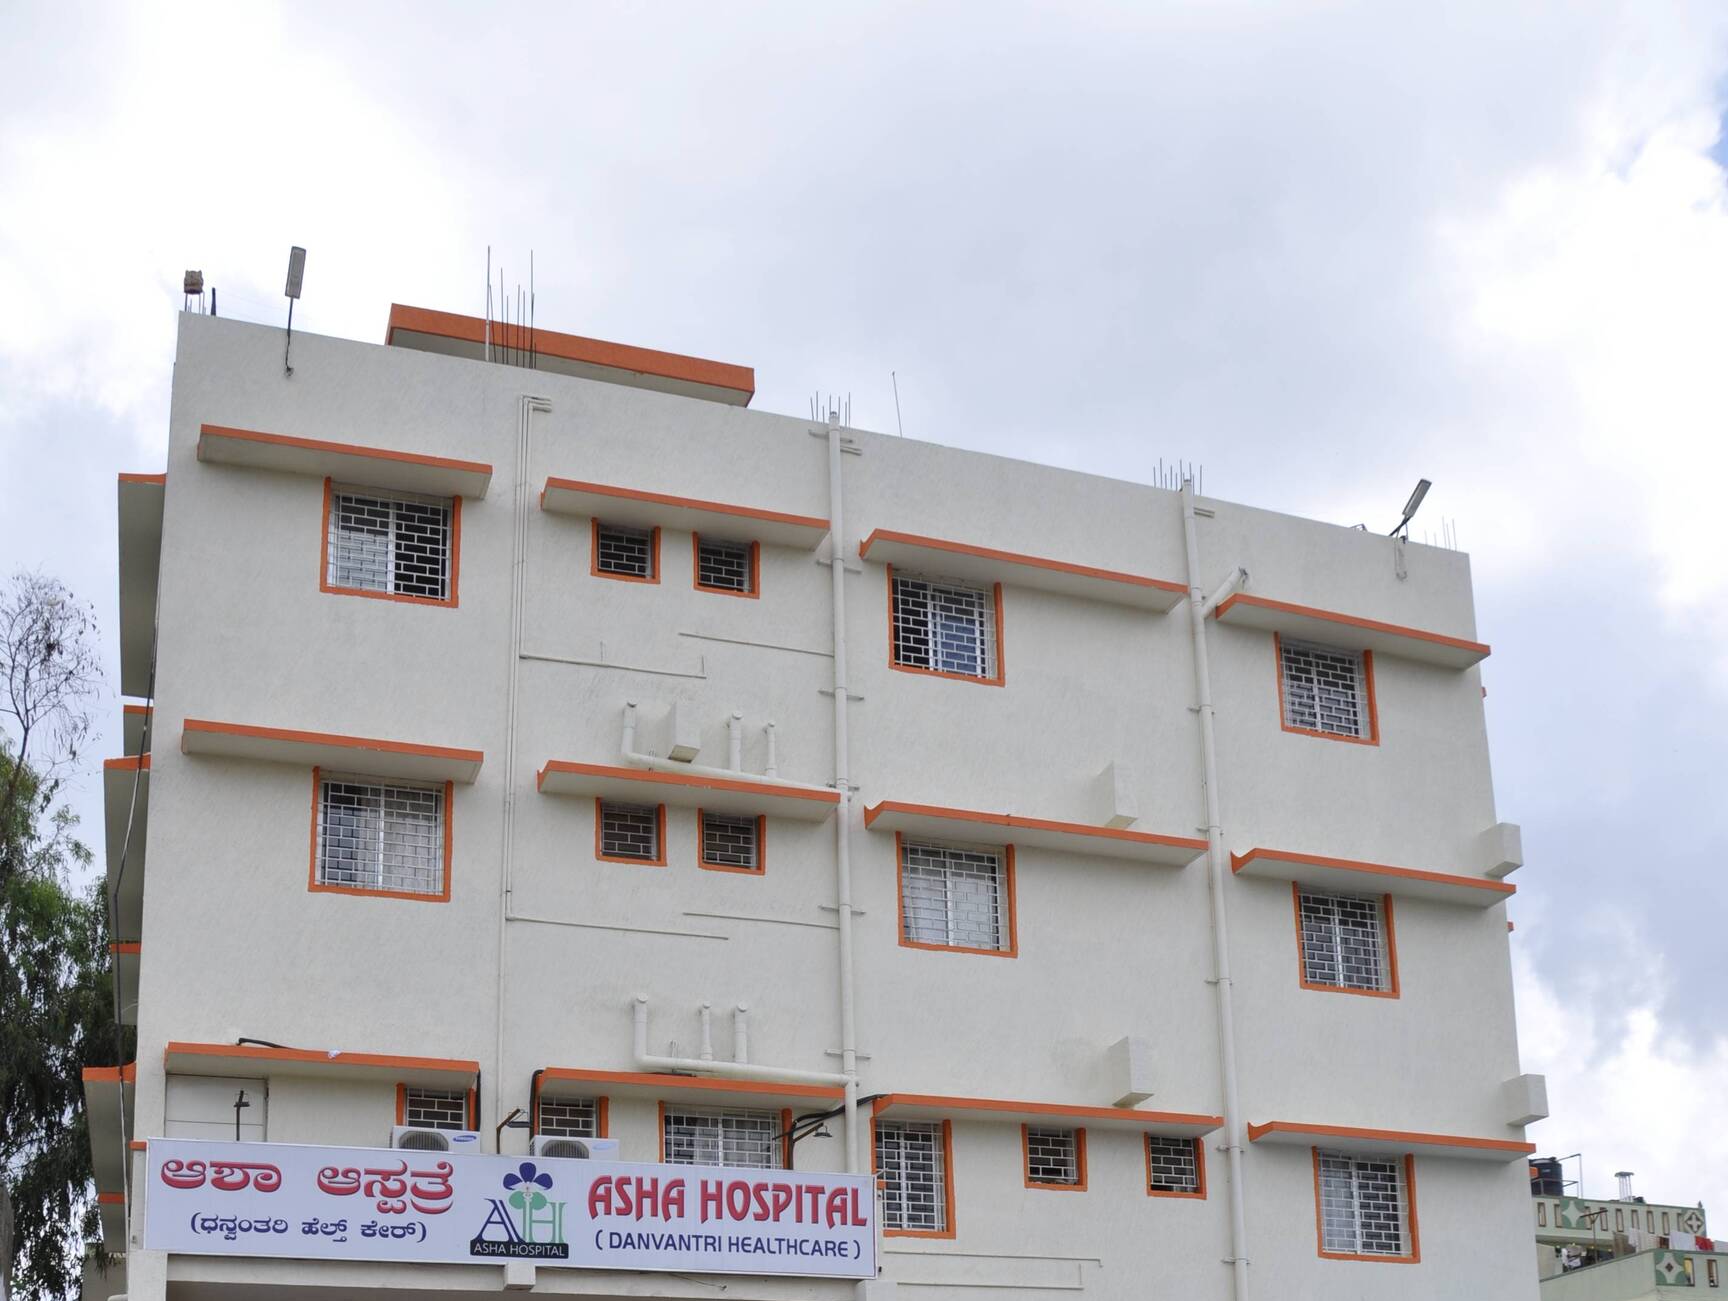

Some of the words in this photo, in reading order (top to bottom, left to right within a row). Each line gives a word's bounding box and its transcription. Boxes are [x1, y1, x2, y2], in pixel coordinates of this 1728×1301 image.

[160, 1159, 282, 1193] ಆಶಾ
[317, 1159, 454, 1215] ಆಸ್ಪತ್ರೆ
[588, 1175, 686, 1223] ASHA
[700, 1179, 867, 1229] HOSPITAL
[301, 1217, 348, 1242] ಹೆಲ್ತ್
[473, 1242, 507, 1254] ASHA
[509, 1244, 566, 1257] HOSPITAL
